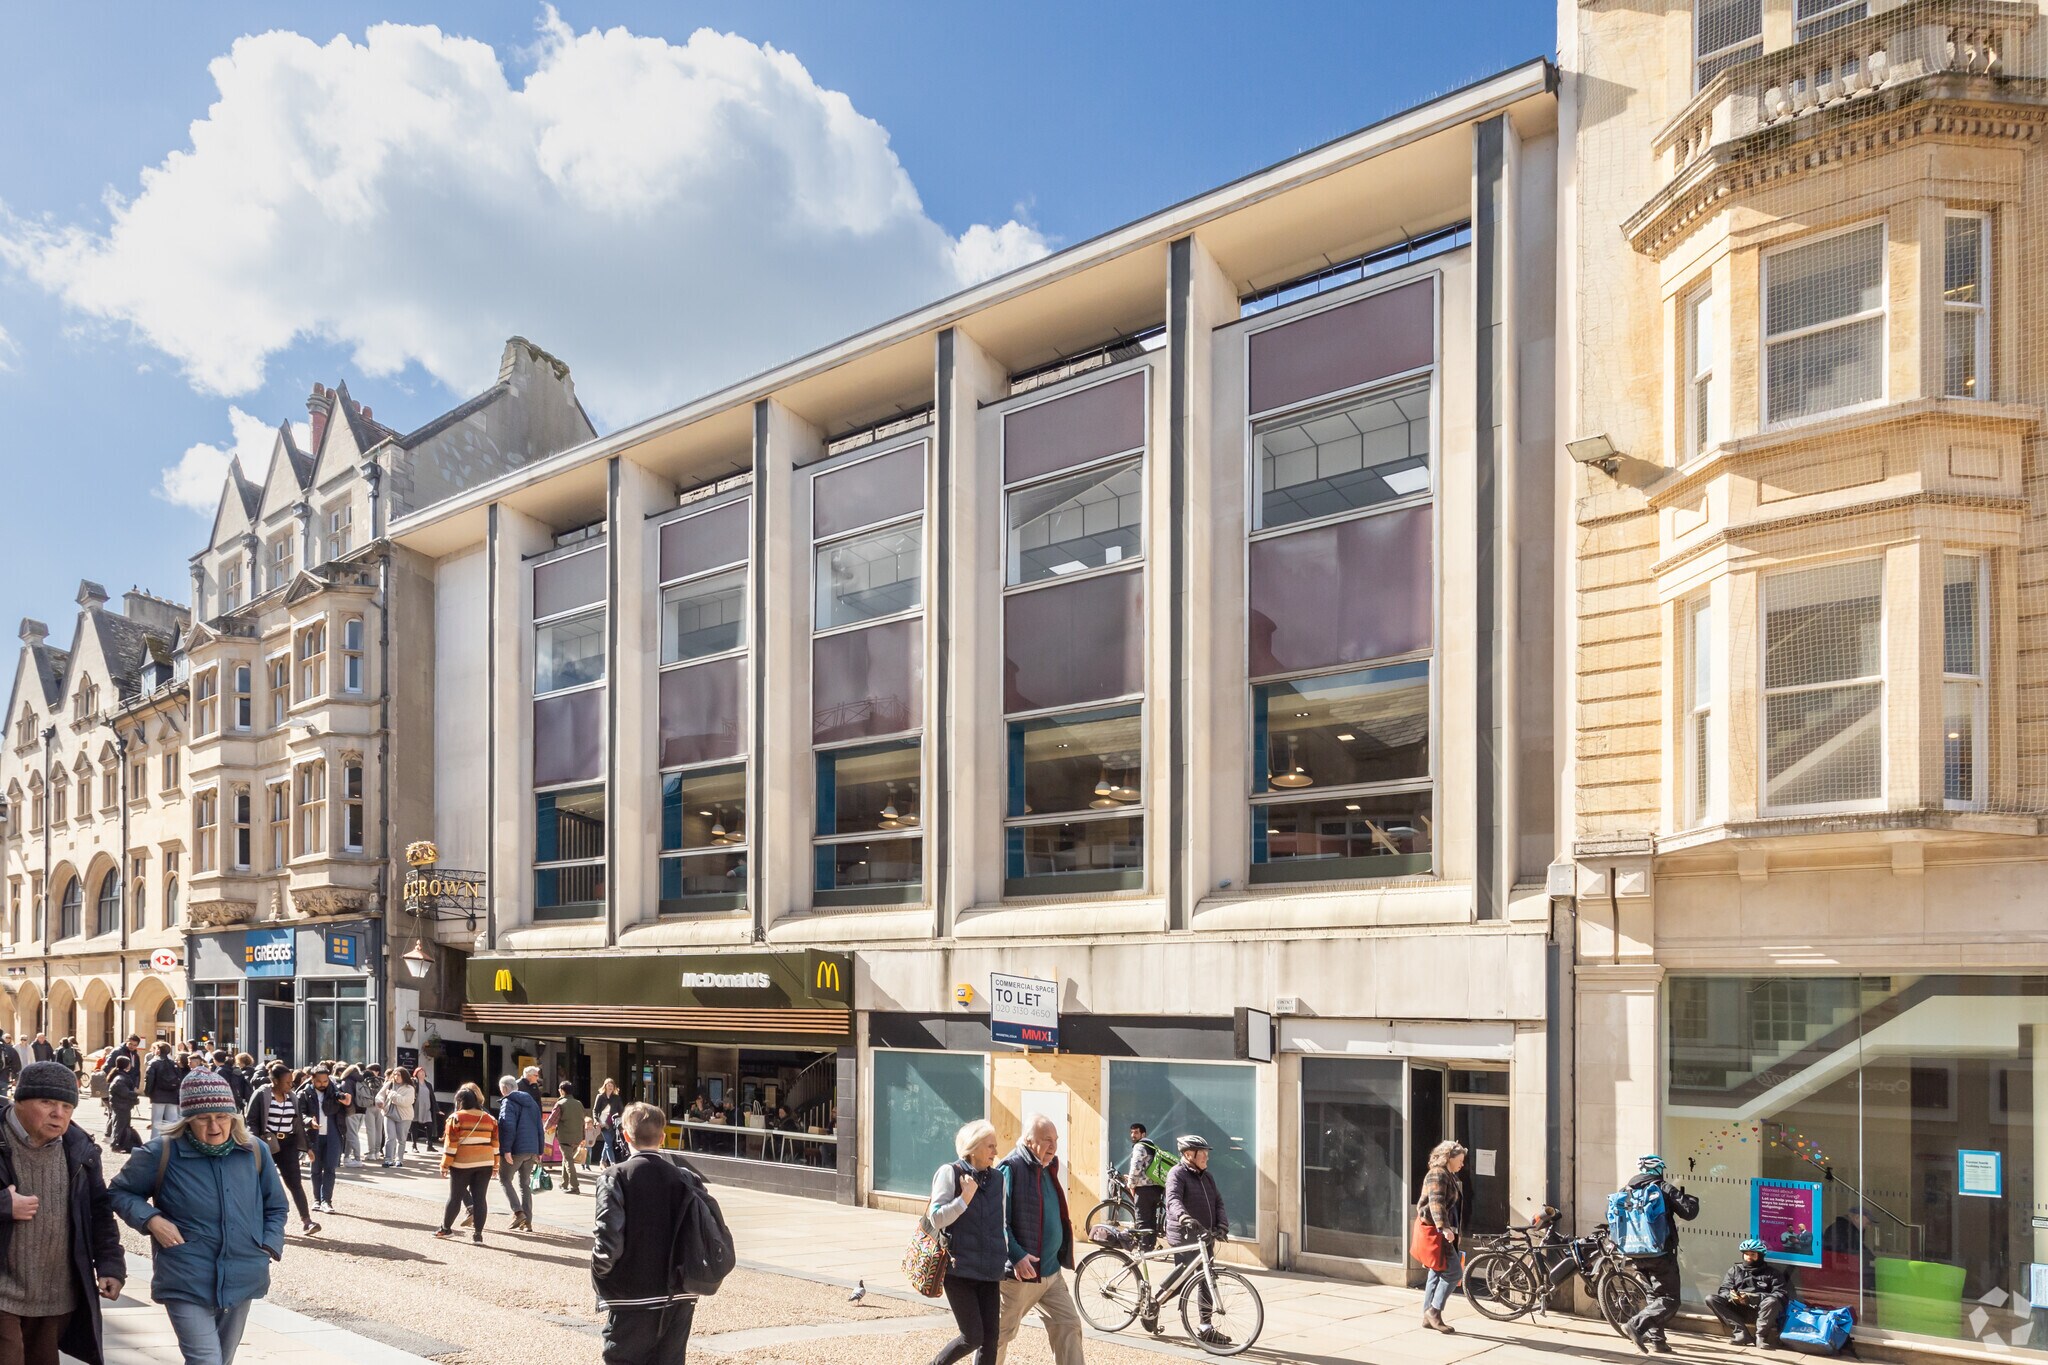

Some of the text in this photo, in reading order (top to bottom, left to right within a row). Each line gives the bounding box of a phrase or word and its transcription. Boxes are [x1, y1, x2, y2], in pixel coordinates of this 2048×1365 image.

[410, 879, 480, 899] CROWN
[254, 943, 291, 962] GREGGS
[681, 972, 771, 989] McDonald's
[995, 979, 1055, 993] COMMERCIAL SPACE
[995, 988, 1041, 1007] TO LET
[995, 1004, 1051, 1018] 020 3130 4650
